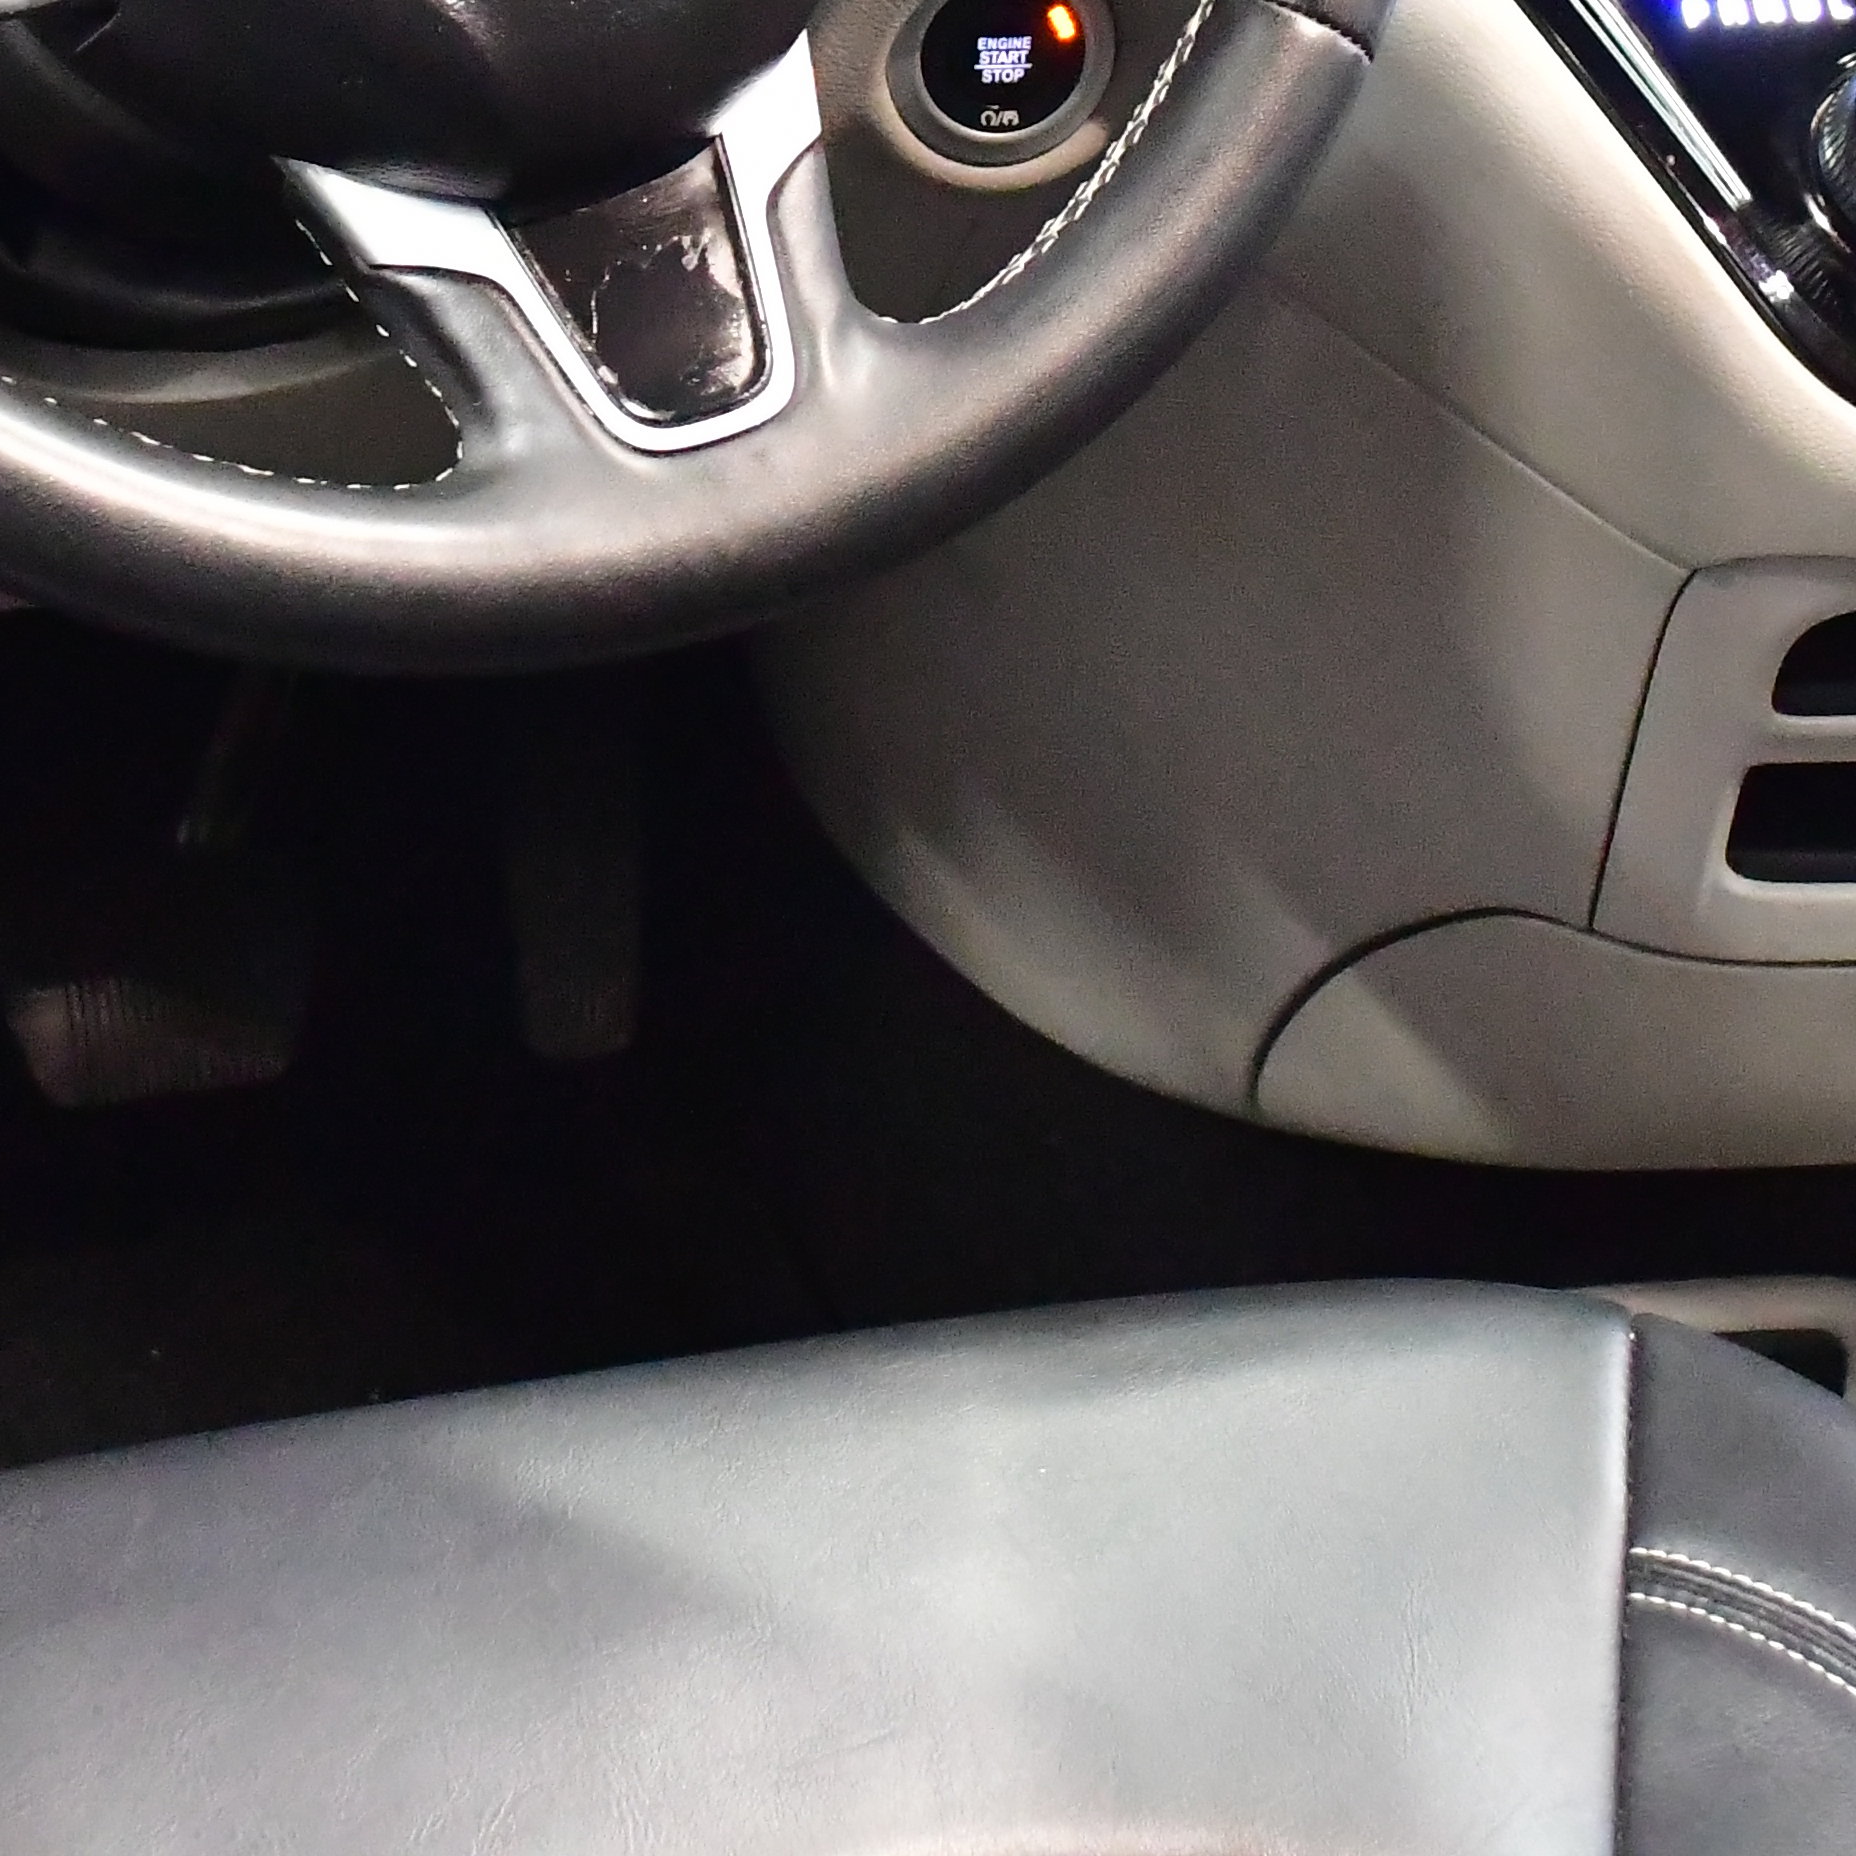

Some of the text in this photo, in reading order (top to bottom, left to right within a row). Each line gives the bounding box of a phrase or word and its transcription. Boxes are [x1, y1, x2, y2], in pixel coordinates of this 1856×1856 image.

[977, 36, 1032, 51] ENGINE
[979, 50, 1028, 65] START
[981, 68, 1025, 83] STOP
